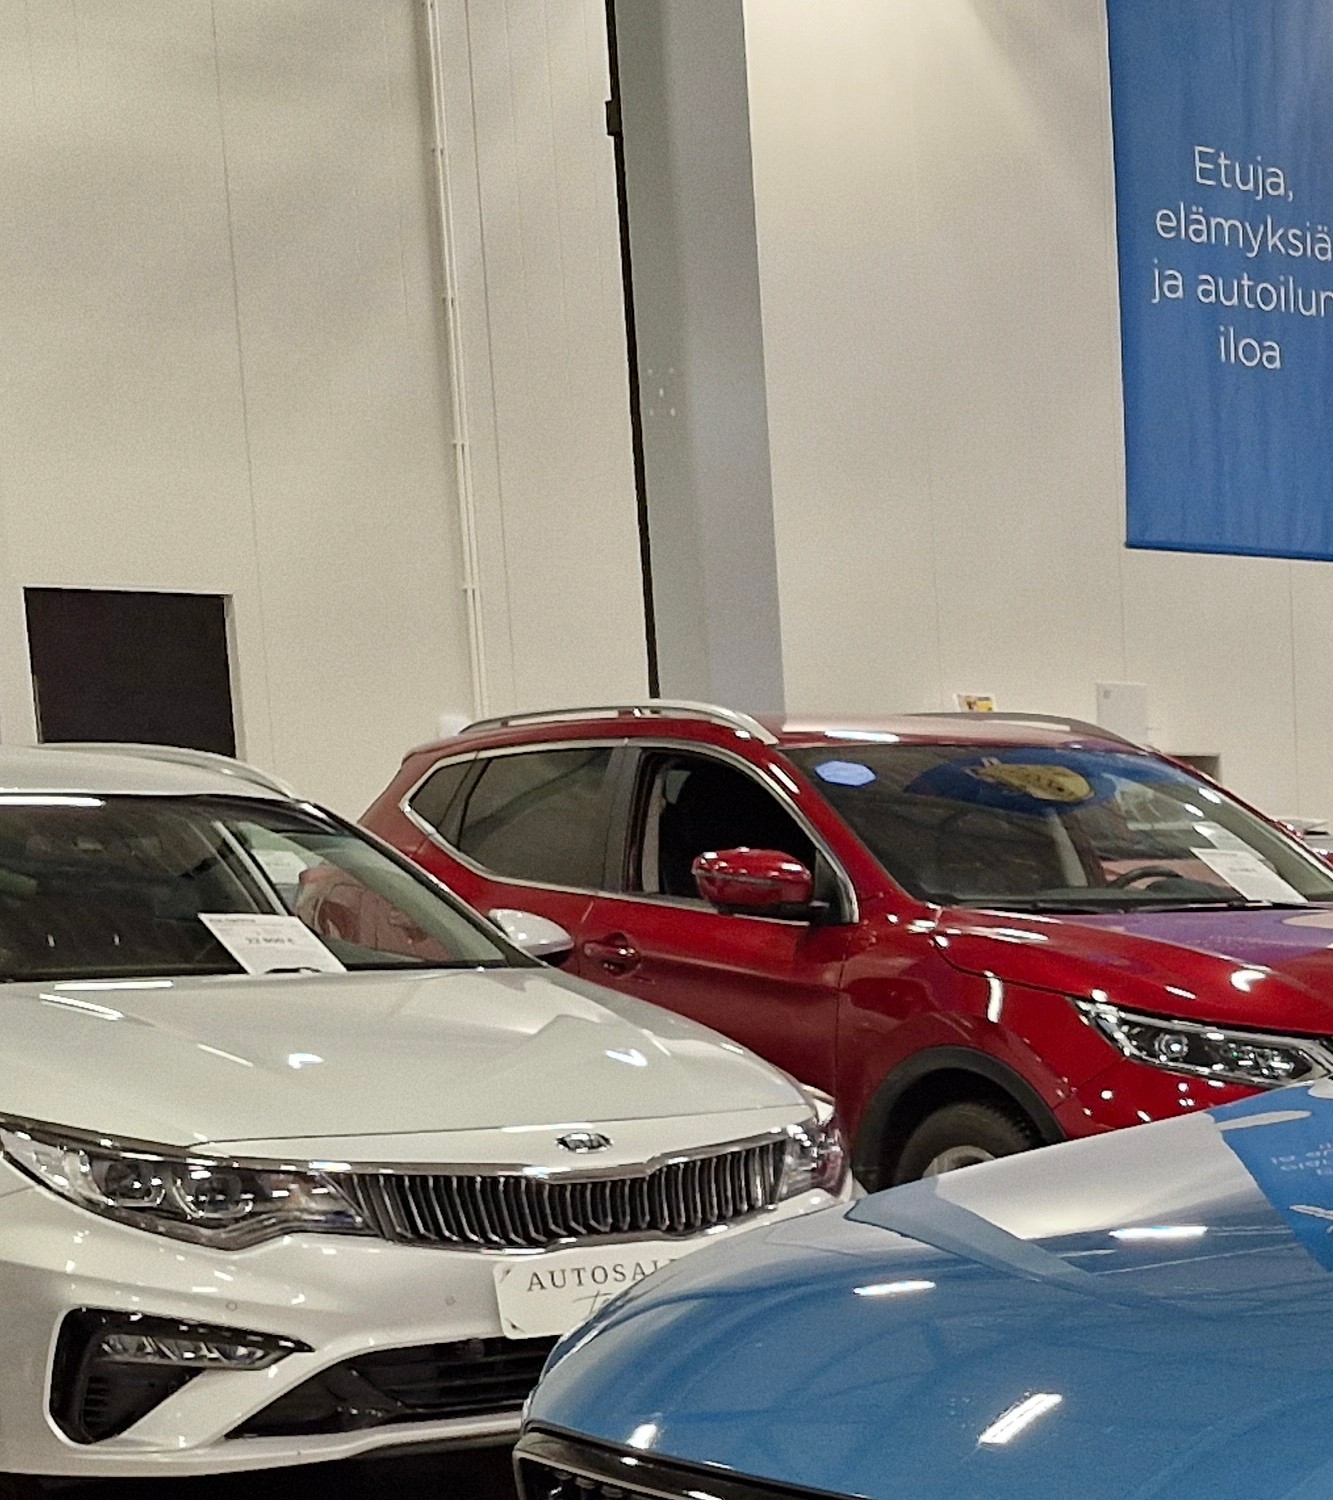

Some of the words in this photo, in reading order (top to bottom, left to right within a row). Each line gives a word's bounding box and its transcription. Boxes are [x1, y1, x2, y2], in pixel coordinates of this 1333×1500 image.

[1193, 145, 1294, 201] Etuja,
[1155, 201, 1333, 261] elämyksiä
[1151, 258, 1184, 304] ja
[1219, 325, 1282, 370] iloa
